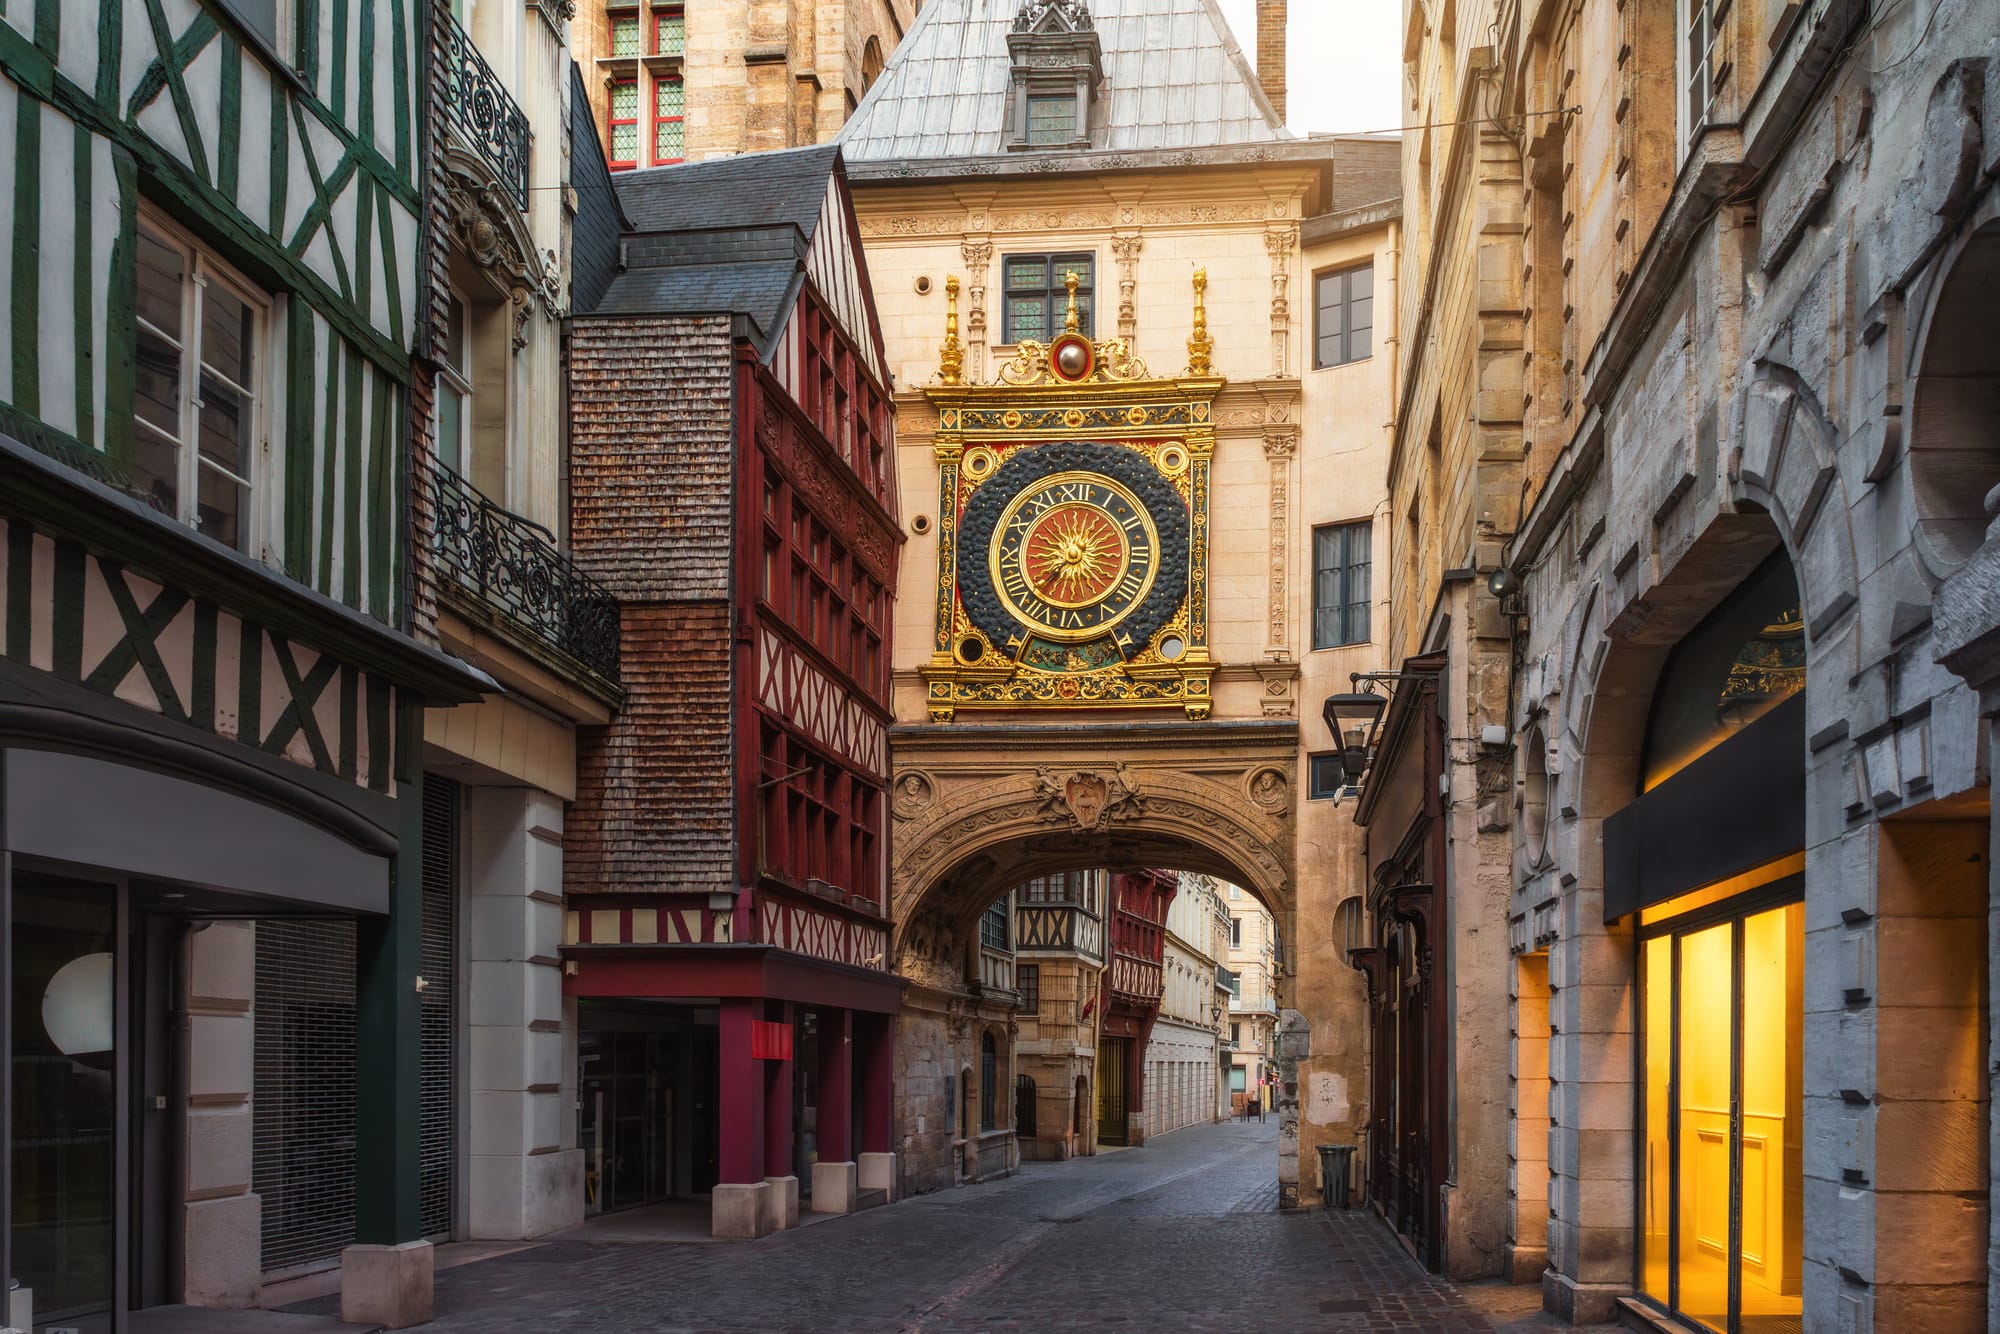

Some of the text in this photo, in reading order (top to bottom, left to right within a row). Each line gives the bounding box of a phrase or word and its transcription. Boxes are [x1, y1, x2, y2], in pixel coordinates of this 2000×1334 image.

[1060, 484, 1090, 502] XII
[1102, 492, 1114, 508] I
[1028, 490, 1055, 515] XI
[1008, 514, 1030, 536] X
[1122, 515, 1141, 531] II
[1131, 546, 1149, 564] III
[1004, 572, 1028, 606] VIII
[1116, 573, 1142, 602] IIII
[1025, 599, 1050, 624] VII
[1060, 610, 1085, 628] VI
[1100, 603, 1117, 621] V
